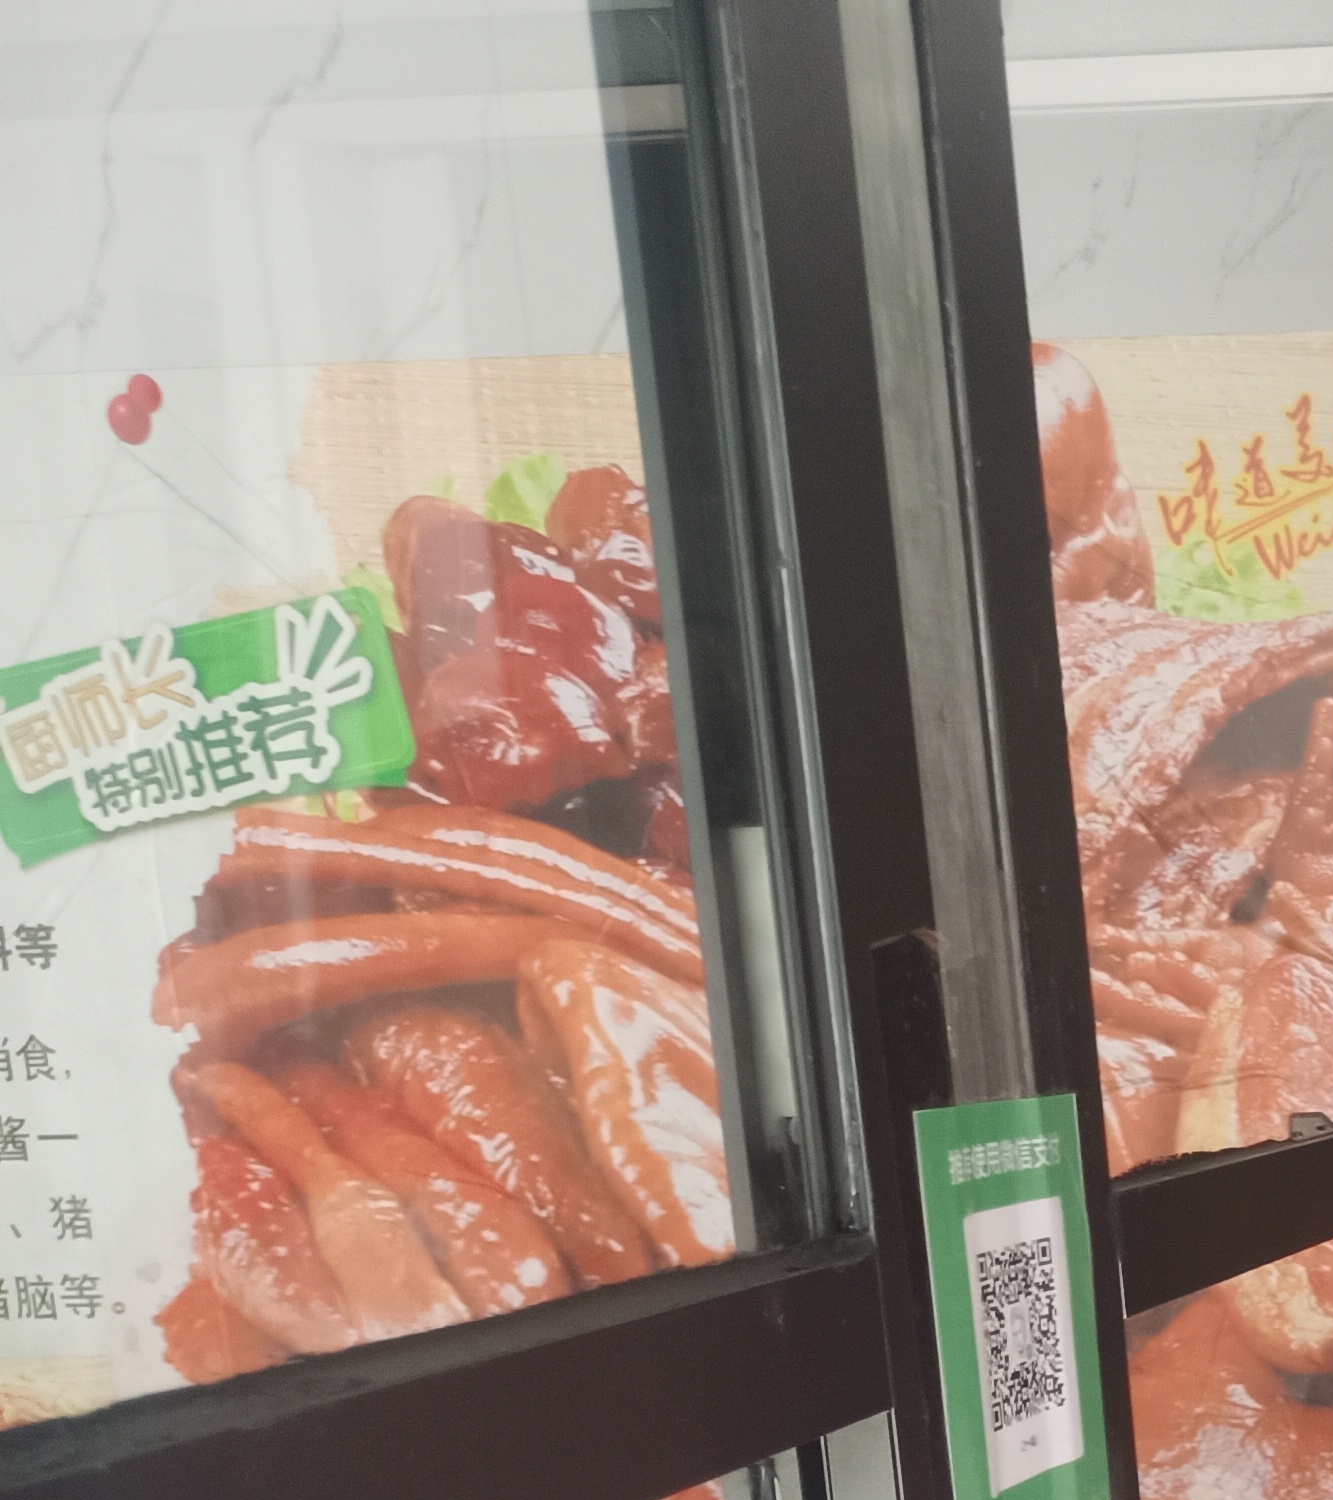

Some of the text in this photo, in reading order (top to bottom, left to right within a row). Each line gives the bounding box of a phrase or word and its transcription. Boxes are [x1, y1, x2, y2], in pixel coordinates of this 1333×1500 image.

[84, 687, 328, 817] 特别推荐
[0, 1273, 127, 1321] 脑等。
